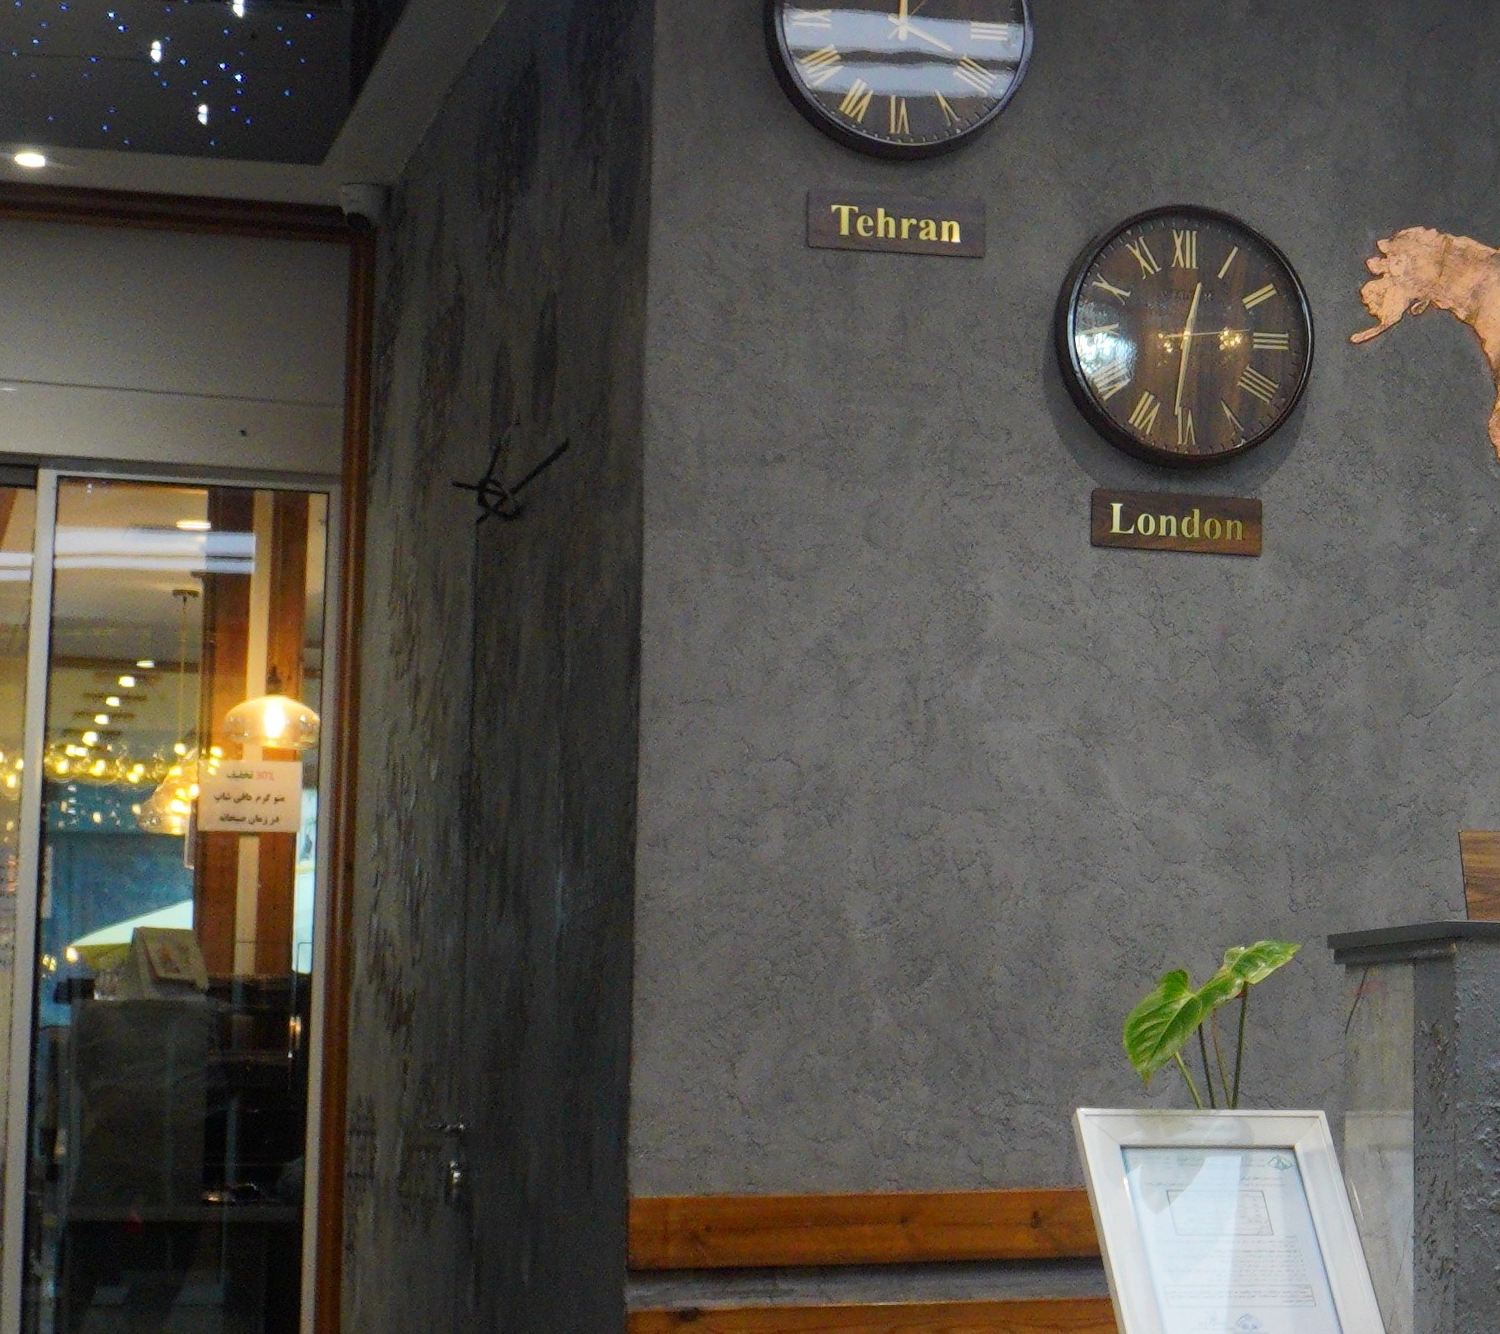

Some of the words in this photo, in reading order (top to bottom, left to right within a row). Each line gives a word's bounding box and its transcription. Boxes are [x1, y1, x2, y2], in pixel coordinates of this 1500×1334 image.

[970, 21, 1009, 41] III
[839, 78, 874, 124] VII
[889, 94, 910, 135] VI
[830, 203, 962, 245] Tehran
[1125, 236, 1162, 280] XI
[1171, 229, 1199, 269] XII
[1092, 273, 1131, 306] X
[1242, 283, 1278, 309] II
[1252, 331, 1290, 351] III
[1128, 390, 1162, 435] VII
[1109, 502, 1245, 543] London
